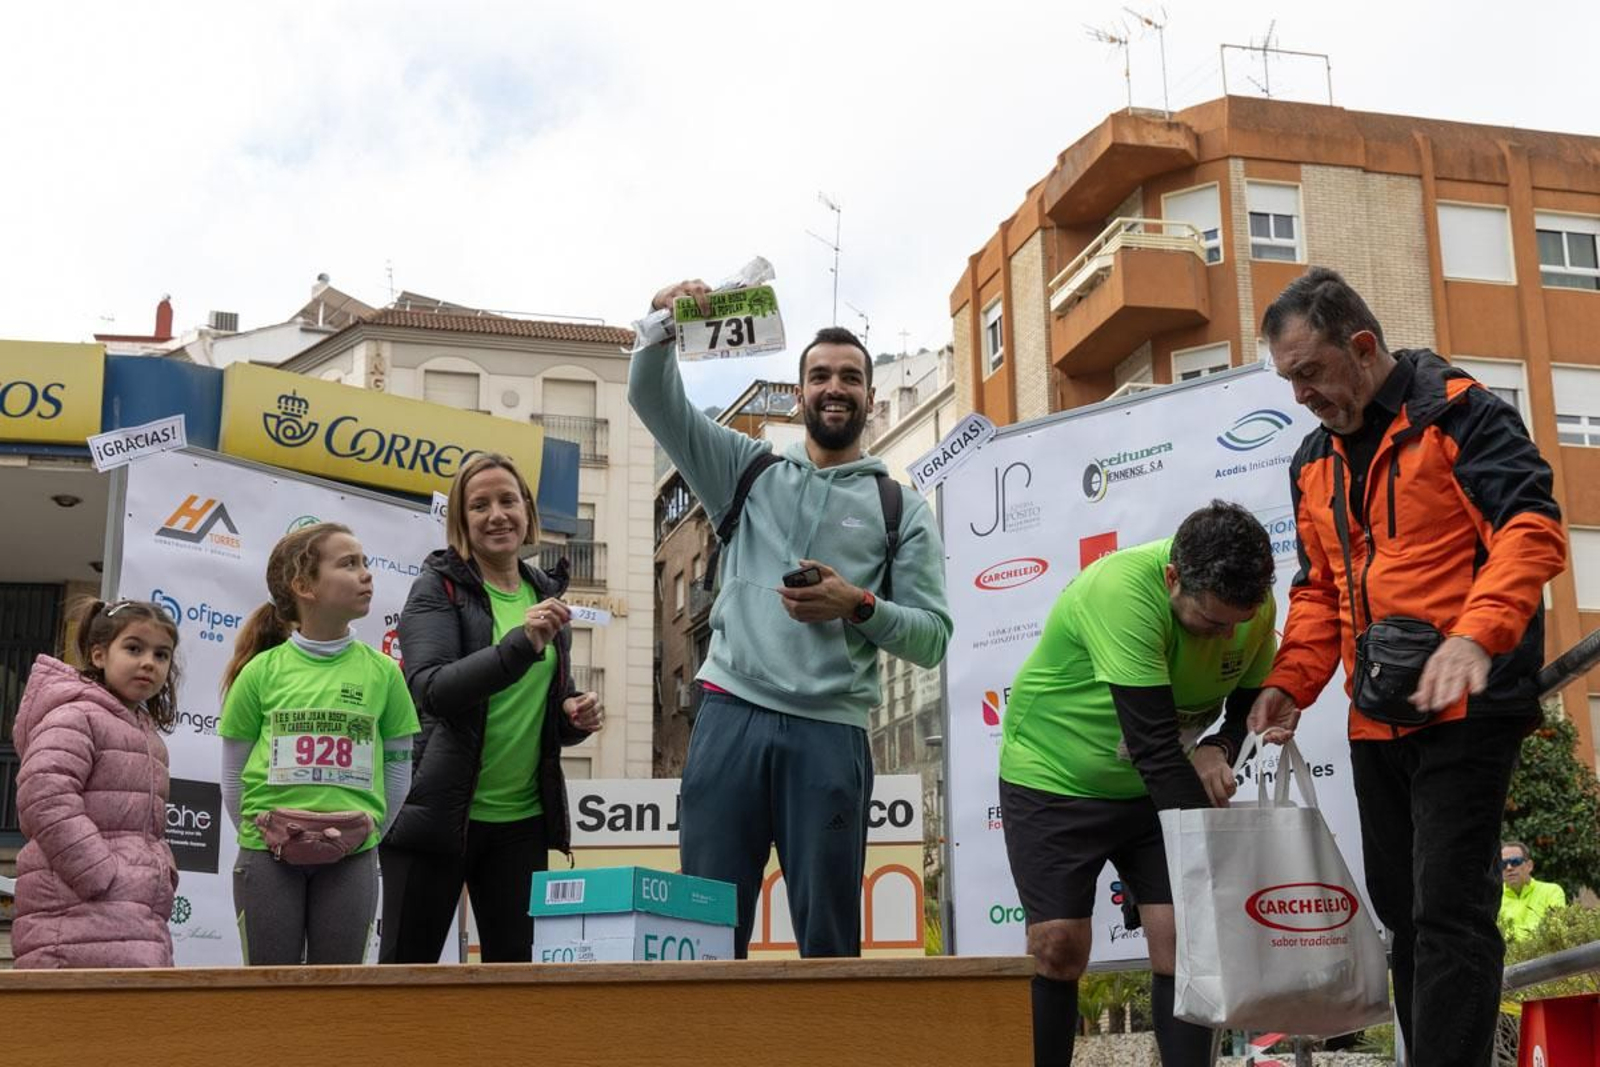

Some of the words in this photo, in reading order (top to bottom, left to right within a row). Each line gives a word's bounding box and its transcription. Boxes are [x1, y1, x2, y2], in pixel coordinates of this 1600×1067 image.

[705, 315, 756, 350] 731
[0, 380, 66, 420] OS
[96, 424, 177, 462] ¡GRACIAS!
[324, 414, 513, 479] CORRE
[1215, 465, 1248, 479] Acodis
[208, 532, 241, 549] TORRES
[367, 556, 424, 577] VITALD
[981, 564, 1042, 585] CARCHELEJO
[187, 603, 243, 630] ofiper
[579, 608, 598, 621] 731
[295, 735, 353, 768] 928
[575, 794, 661, 833] San
[1257, 897, 1349, 915] CARCHELEJO
[1270, 936, 1298, 948] sabor
